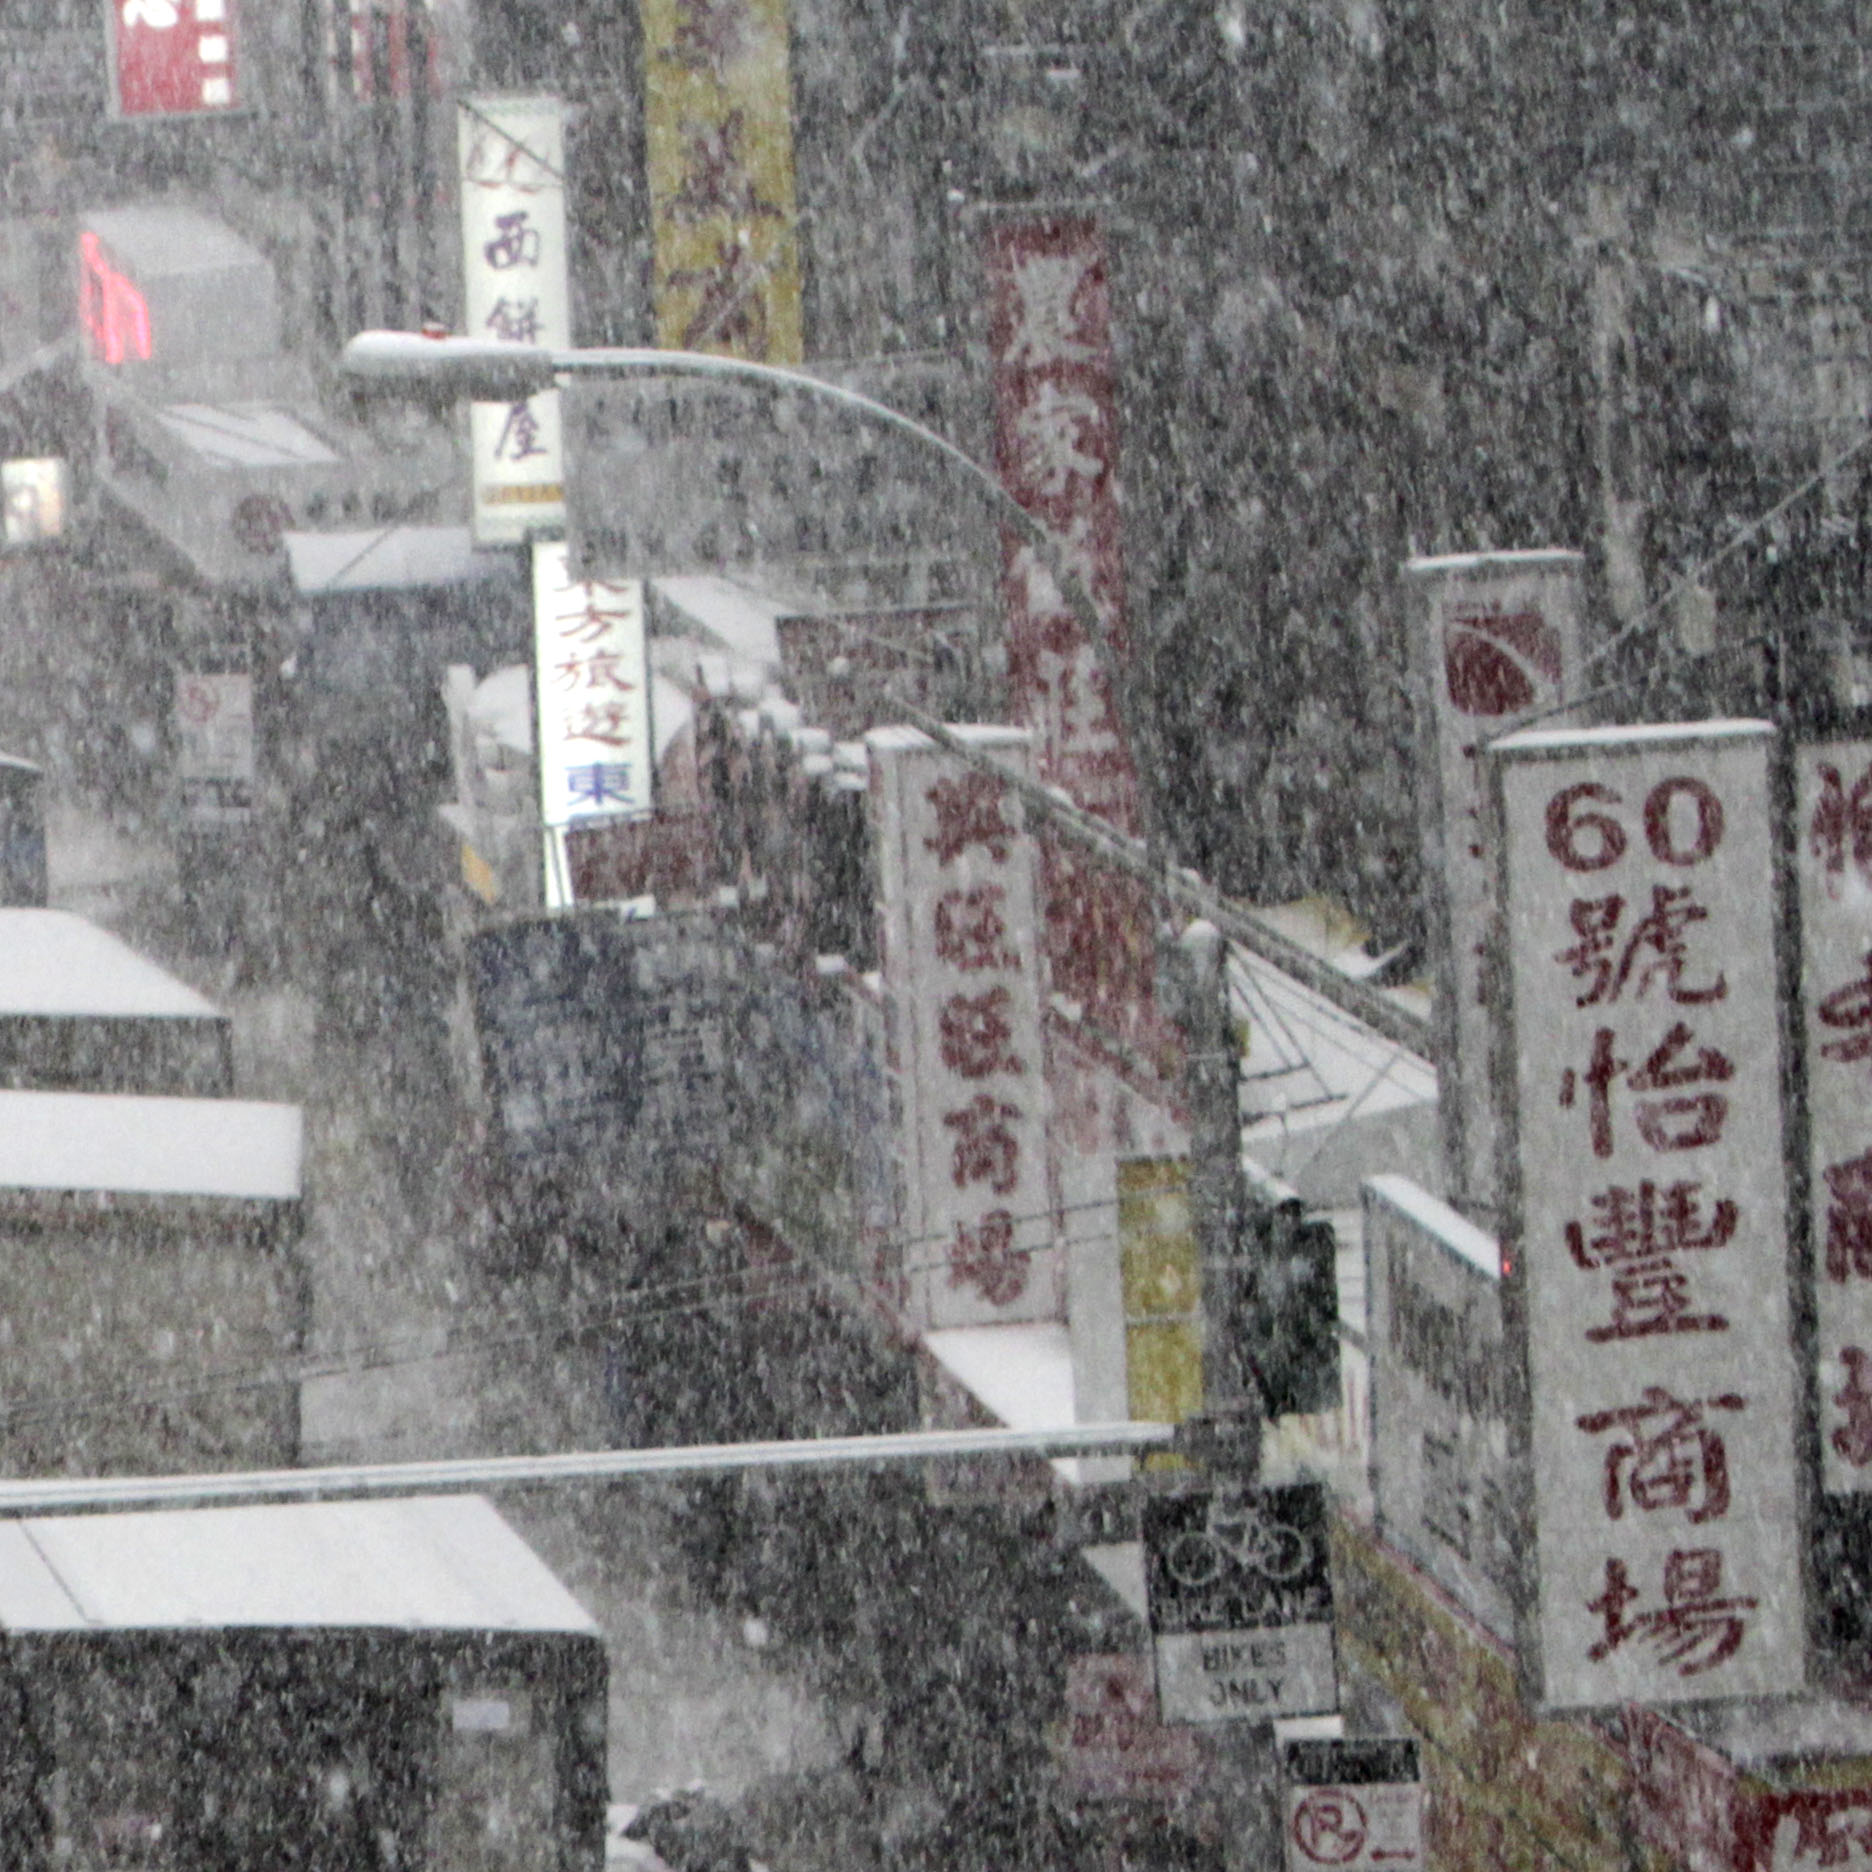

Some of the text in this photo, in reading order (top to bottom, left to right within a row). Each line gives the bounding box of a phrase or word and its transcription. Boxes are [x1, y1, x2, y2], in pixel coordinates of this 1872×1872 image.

[551, 572, 637, 748] 方旅遊
[1202, 1641, 1288, 1671] BIKES
